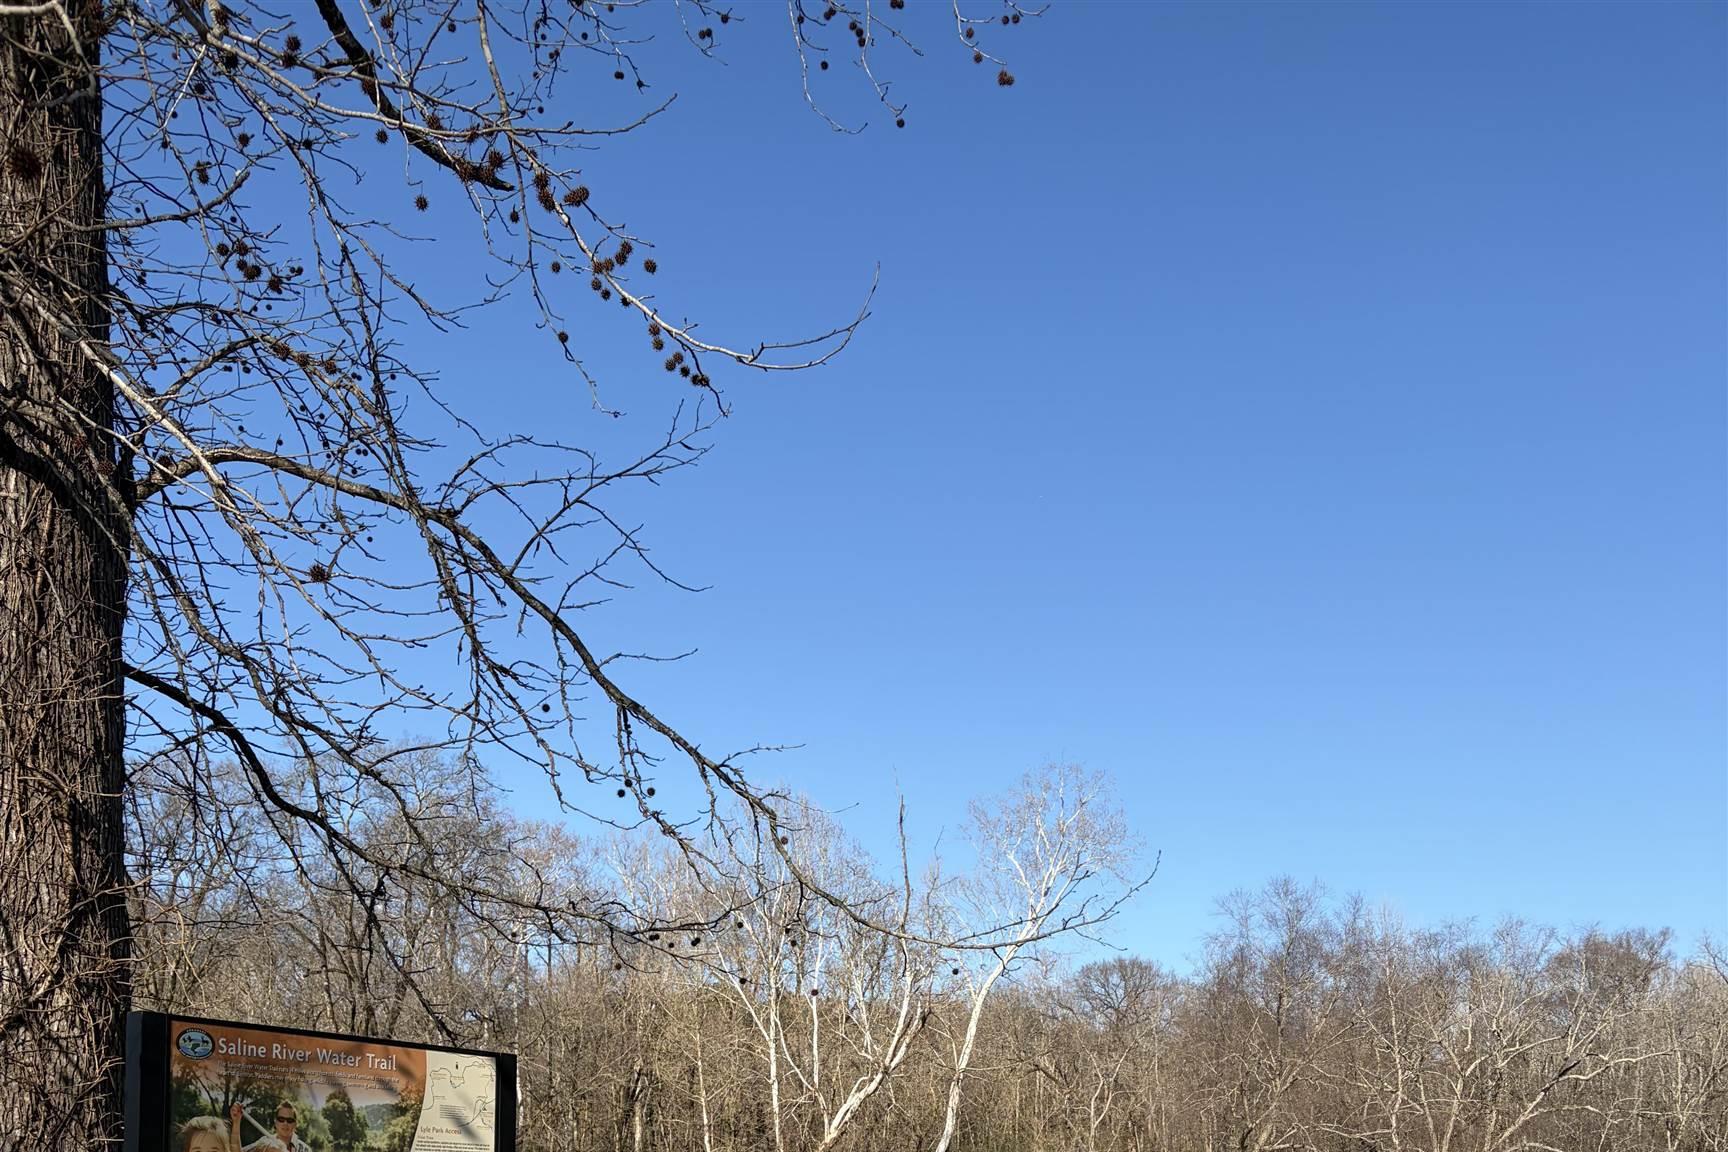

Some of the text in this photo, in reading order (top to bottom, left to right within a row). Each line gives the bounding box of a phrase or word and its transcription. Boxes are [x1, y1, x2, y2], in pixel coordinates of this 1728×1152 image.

[218, 1037, 267, 1058] Saline
[272, 1043, 312, 1062] River
[316, 1047, 362, 1067] Water
[366, 1053, 397, 1071] Trail
[432, 1126, 444, 1134] Park
